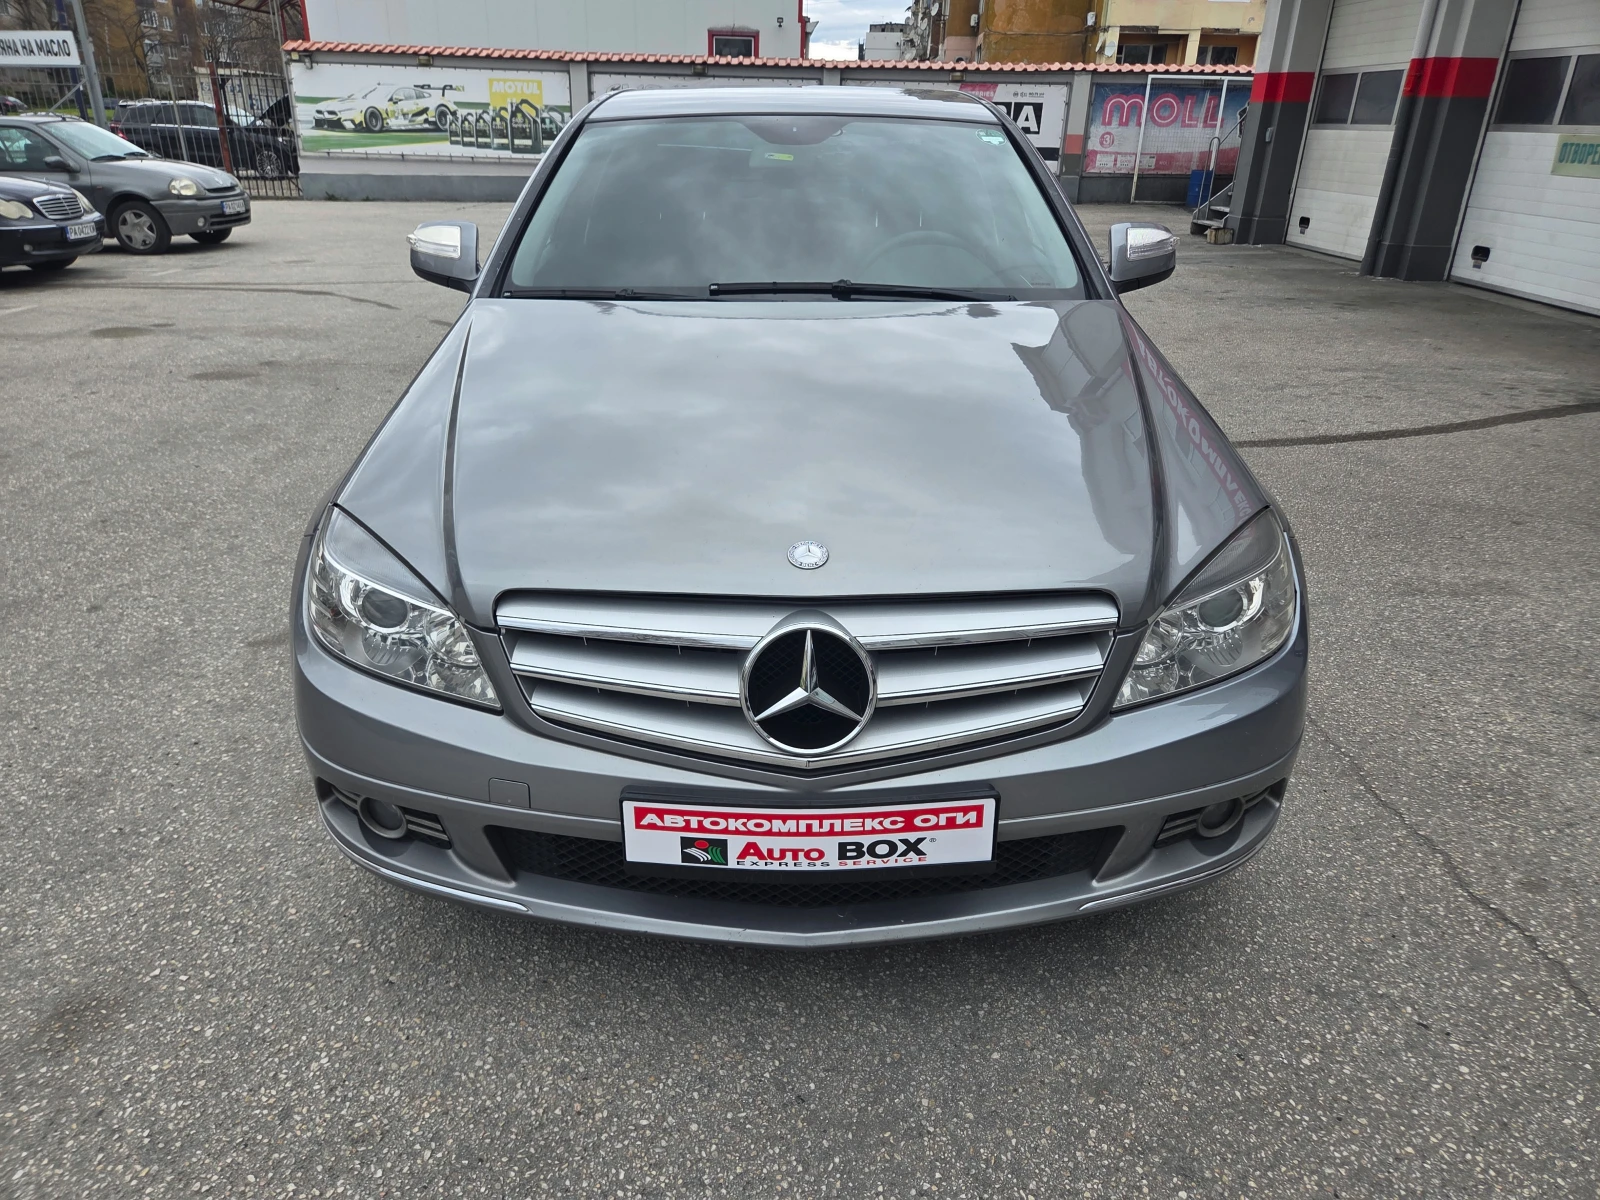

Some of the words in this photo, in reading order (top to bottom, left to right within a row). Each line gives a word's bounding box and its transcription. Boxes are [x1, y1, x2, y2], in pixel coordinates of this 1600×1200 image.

[0, 38, 21, 57] ЯНА
[19, 39, 36, 57] НА
[34, 39, 71, 57] МАСЛО
[492, 81, 540, 94] MOTUL
[1101, 92, 1225, 128] MOLL
[1558, 142, 1600, 165] ОТВОРЕ
[639, 813, 905, 833] АВТОКОМПЛЕКС
[913, 811, 977, 828] ОГИ
[736, 860, 830, 868] EXPRESS
[839, 857, 927, 867] SERVICE
